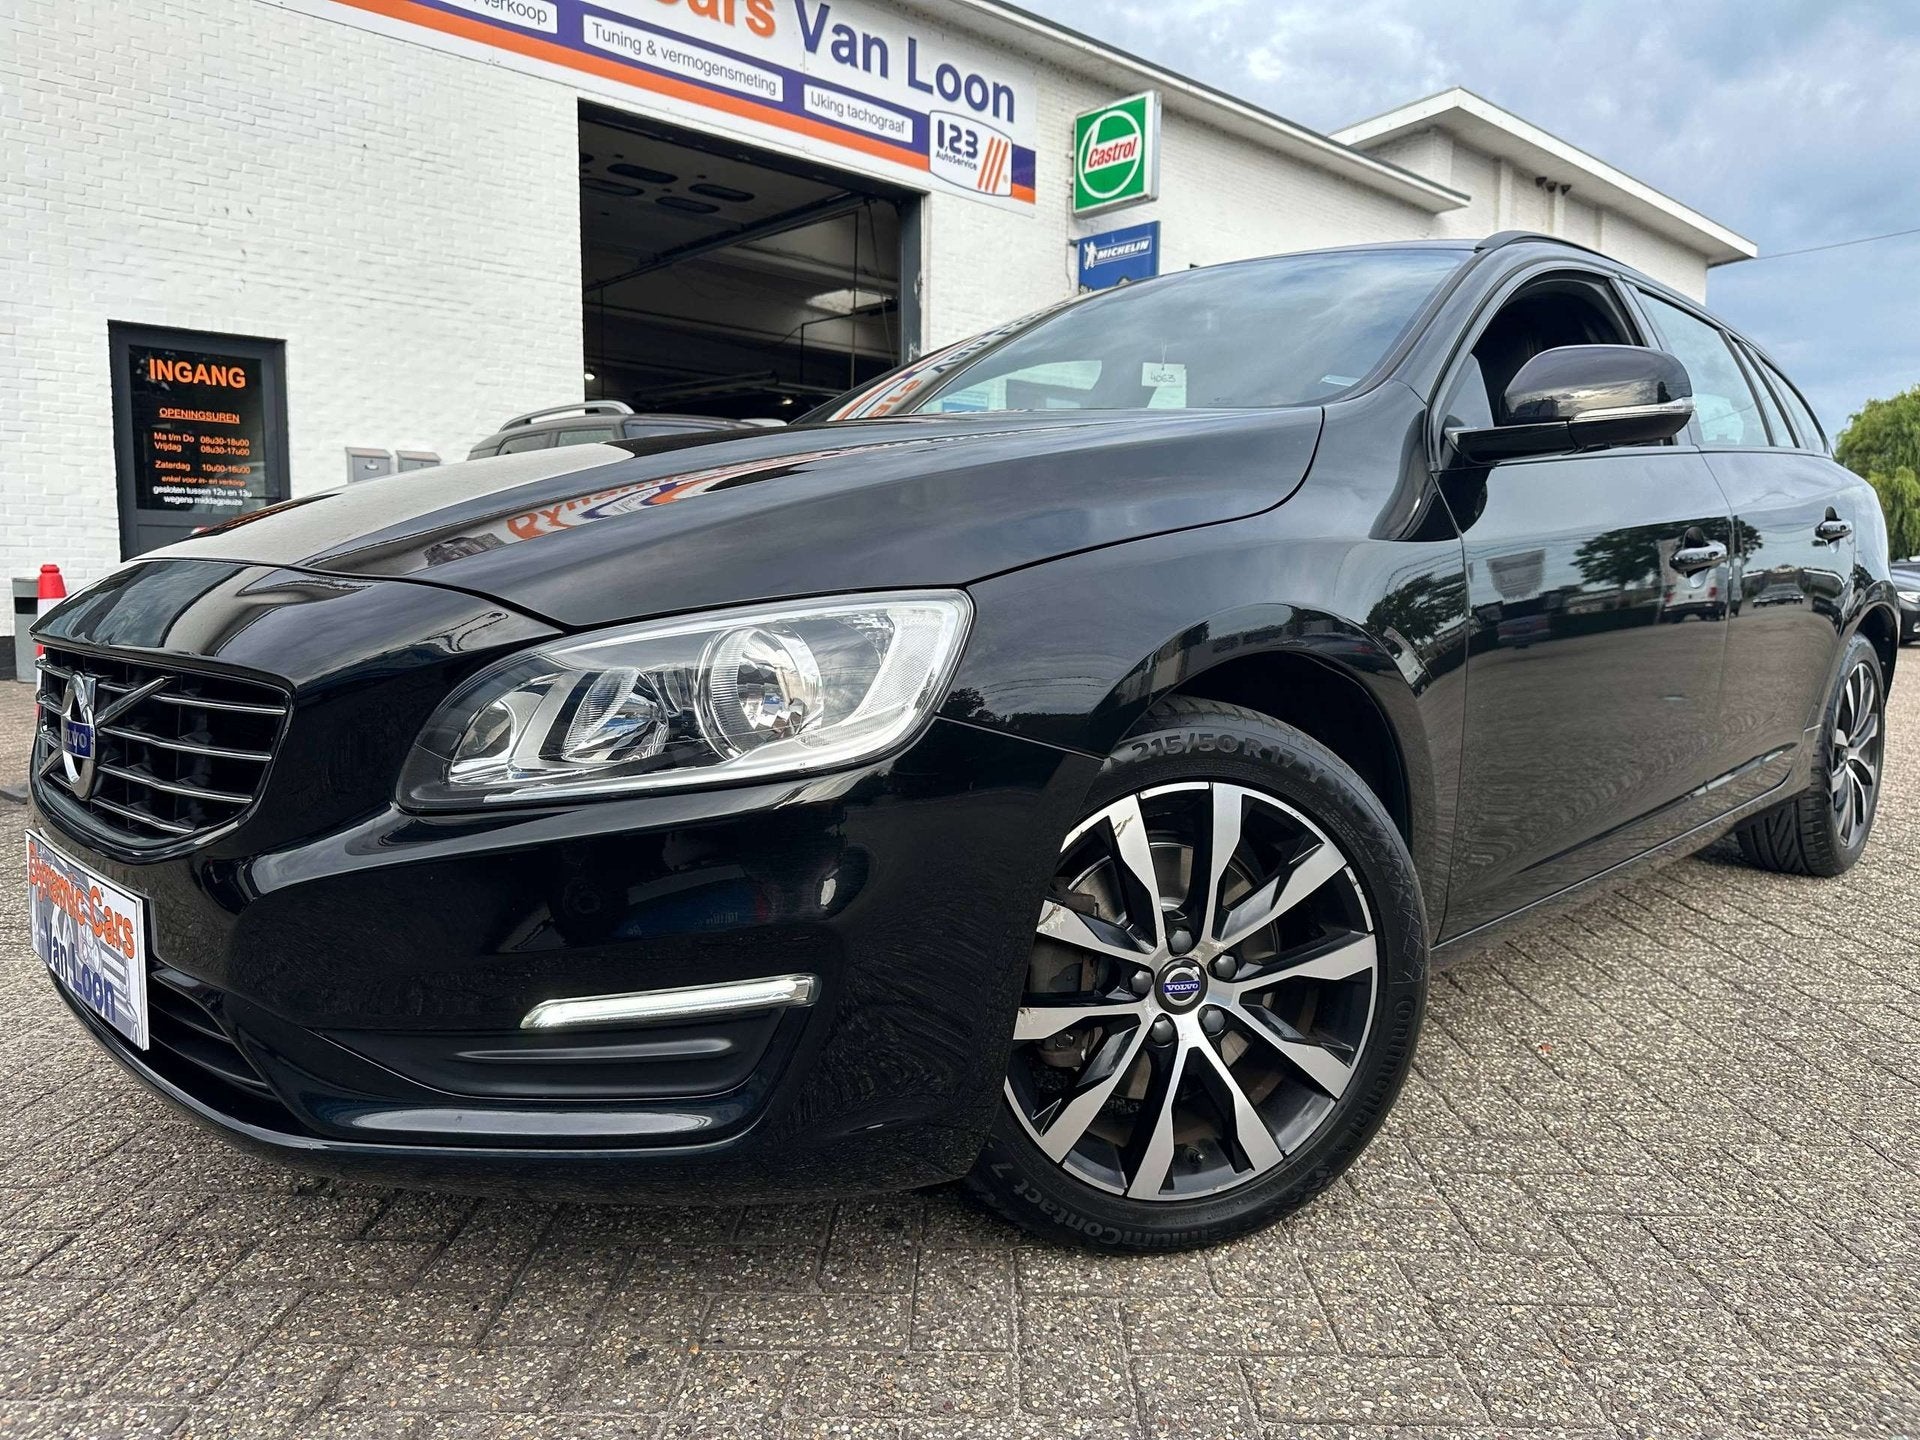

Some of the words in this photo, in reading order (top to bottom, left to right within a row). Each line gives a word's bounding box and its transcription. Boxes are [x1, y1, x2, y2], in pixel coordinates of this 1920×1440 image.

[592, 21, 641, 56] Tuning
[646, 39, 657, 57] &
[660, 46, 777, 96] vermogensmeting
[793, 0, 889, 79] Van
[907, 37, 1015, 124] Loon
[847, 100, 906, 135] tachograaf
[936, 150, 977, 171] AutoService
[1087, 136, 1138, 169] Castrol
[1096, 239, 1150, 260] MICHELIN
[150, 358, 246, 389] INGANG
[159, 407, 241, 425] OPENINGSUREN
[153, 432, 167, 441] Ma
[182, 433, 195, 443] Do
[154, 441, 182, 453] Vrijdag
[155, 460, 191, 472] Zaterdag
[153, 485, 186, 496] gesloten
[186, 486, 211, 496] tussen
[212, 487, 226, 496] 12u
[163, 494, 194, 505] wegens
[1132, 732, 1239, 763] 215/50
[28, 840, 86, 926] Dynamic
[89, 885, 135, 960] Cars
[43, 916, 69, 983] Van
[70, 942, 116, 1023] Loon
[1165, 983, 1199, 991] VOLVO
